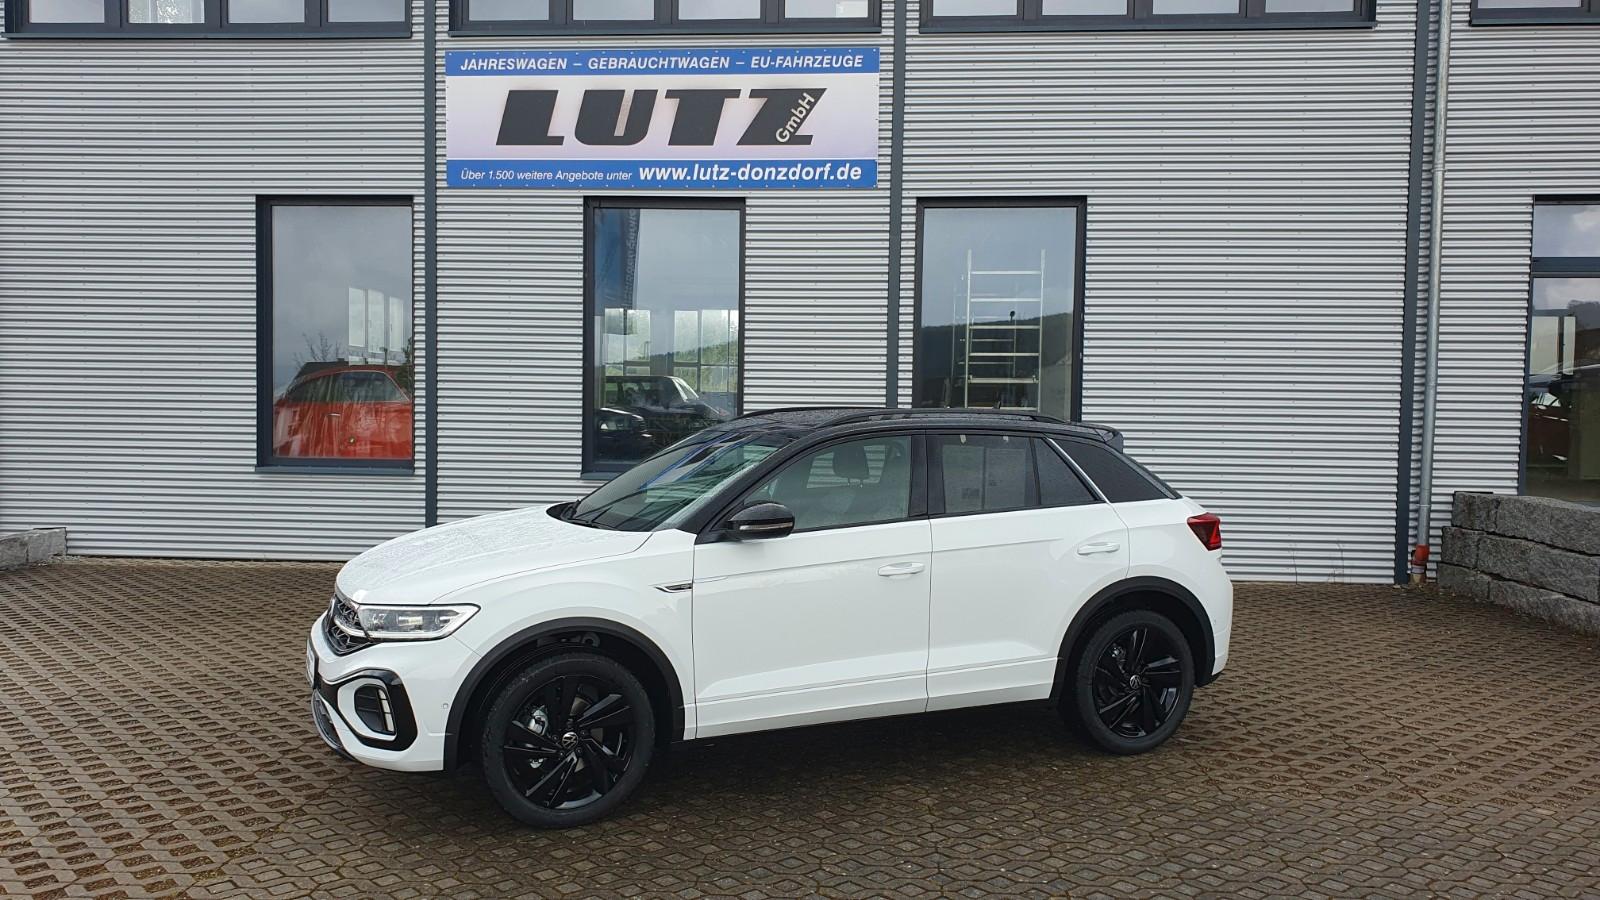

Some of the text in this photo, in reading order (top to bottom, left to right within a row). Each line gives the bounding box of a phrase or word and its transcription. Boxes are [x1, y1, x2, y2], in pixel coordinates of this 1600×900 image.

[460, 57, 567, 71] JAHRESWAGEN
[588, 56, 730, 70] GEBRAUCHTWAGEN
[751, 55, 864, 68] EU-FAHRZEUGE
[496, 88, 827, 146] LUTZ
[775, 92, 815, 143] GmbH
[460, 163, 863, 182] Über 1.500 weitere Angebote unter www.lutz-donzdorf.de
